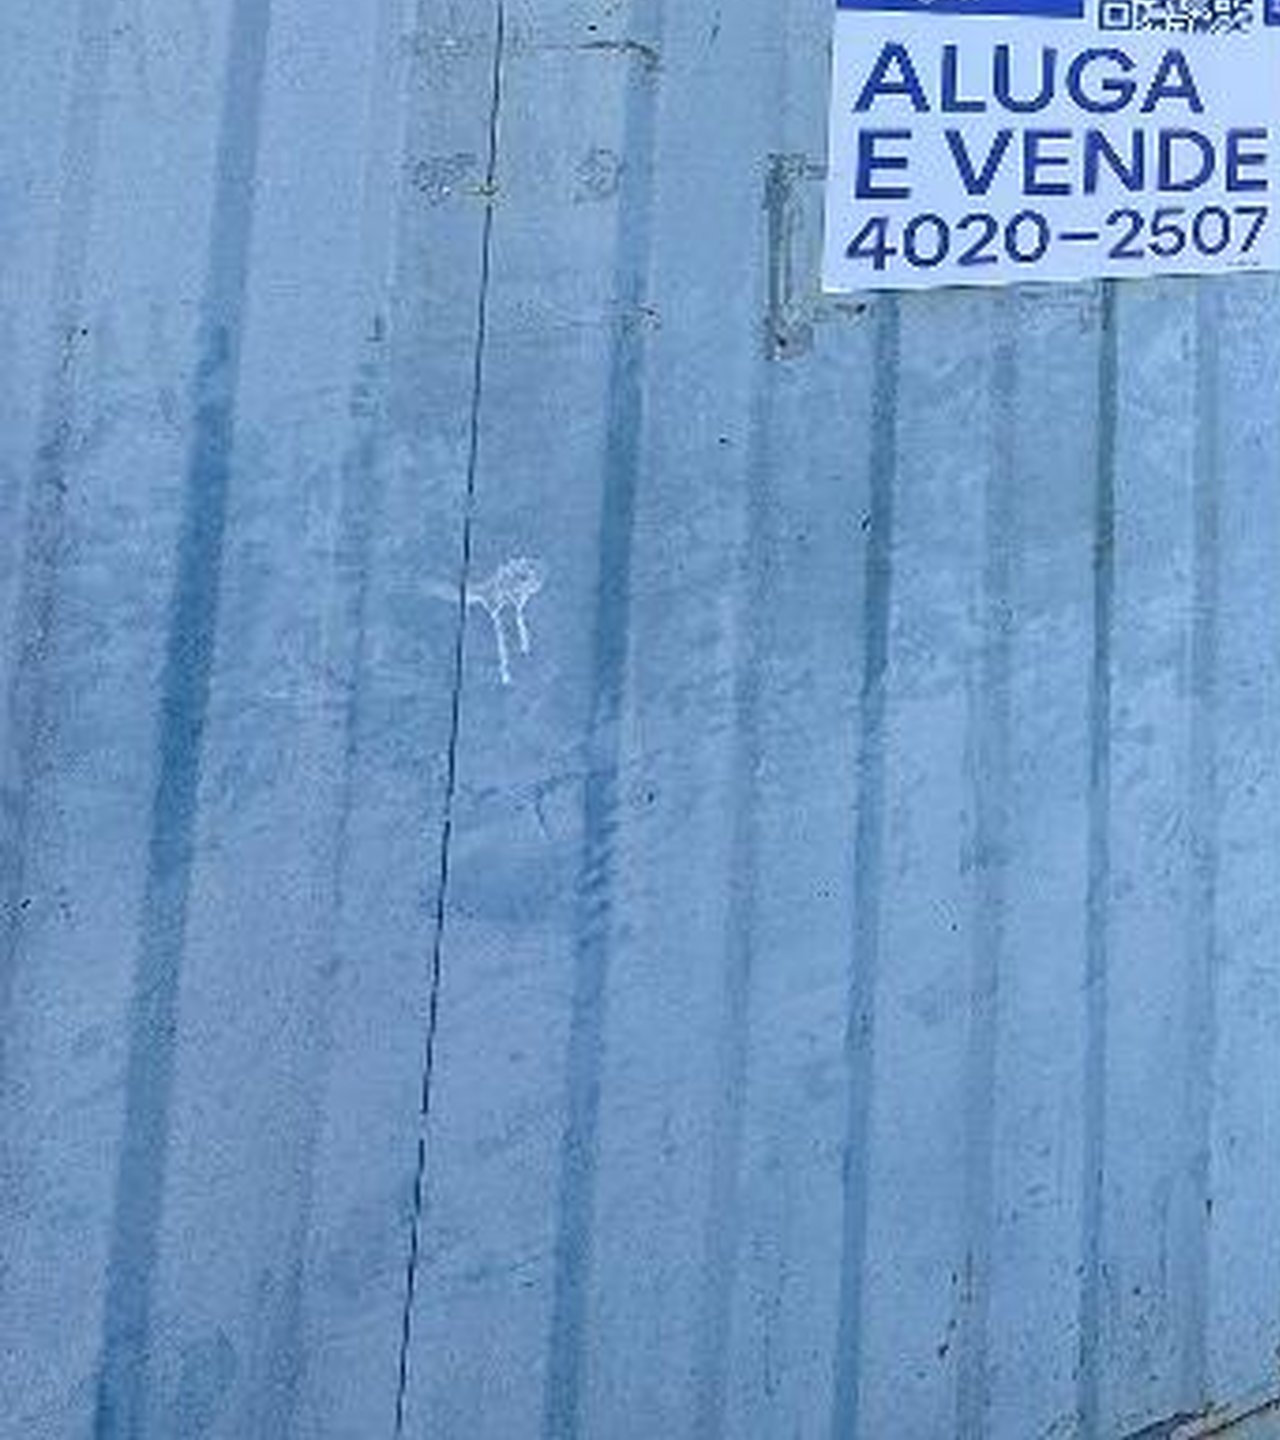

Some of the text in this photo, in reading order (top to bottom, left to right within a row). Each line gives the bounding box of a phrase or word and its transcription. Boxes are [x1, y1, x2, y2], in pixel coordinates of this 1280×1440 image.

[851, 41, 1205, 114] ALUGA
[855, 127, 1269, 200] E VENDE
[845, 205, 1269, 271] 4020-2507
